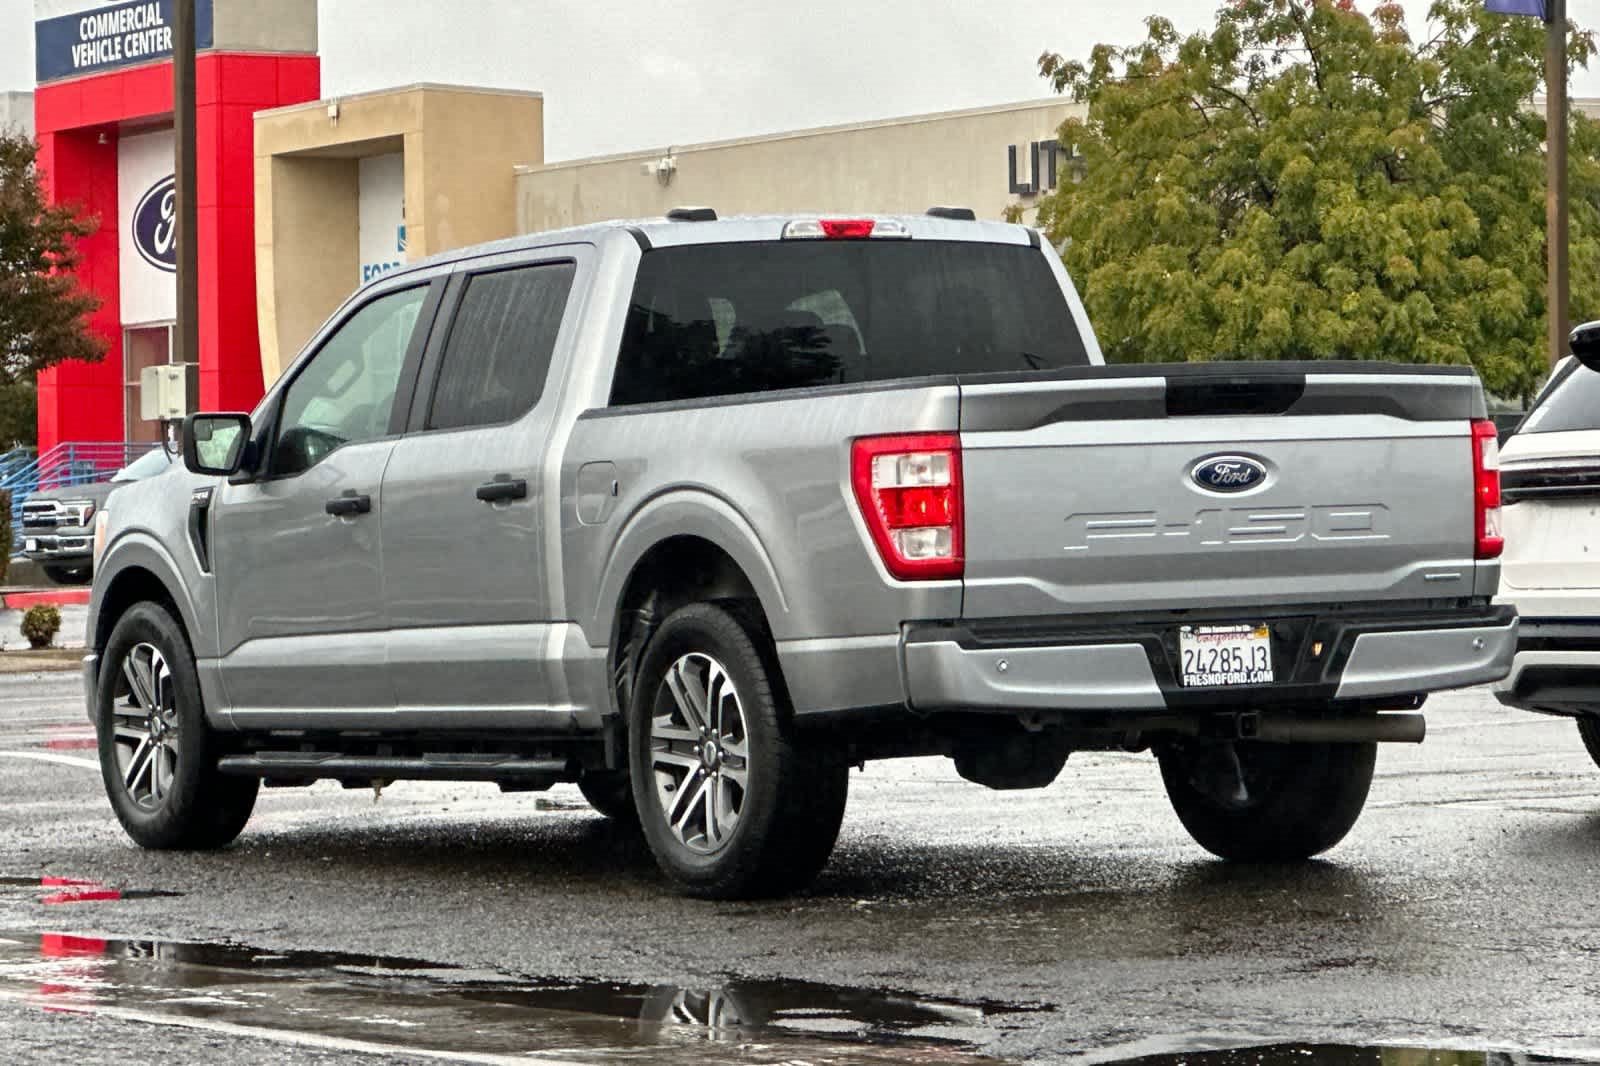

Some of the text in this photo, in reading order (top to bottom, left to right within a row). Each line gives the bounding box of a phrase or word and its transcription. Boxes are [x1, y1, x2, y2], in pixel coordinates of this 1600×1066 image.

[79, 2, 164, 41] COMMERCIAL
[71, 26, 173, 68] VEHICLE CENTER
[1211, 463, 1252, 484] Ford
[1184, 646, 1268, 675] 24285J3
[1183, 671, 1274, 687] FRESNOFORD.COM
